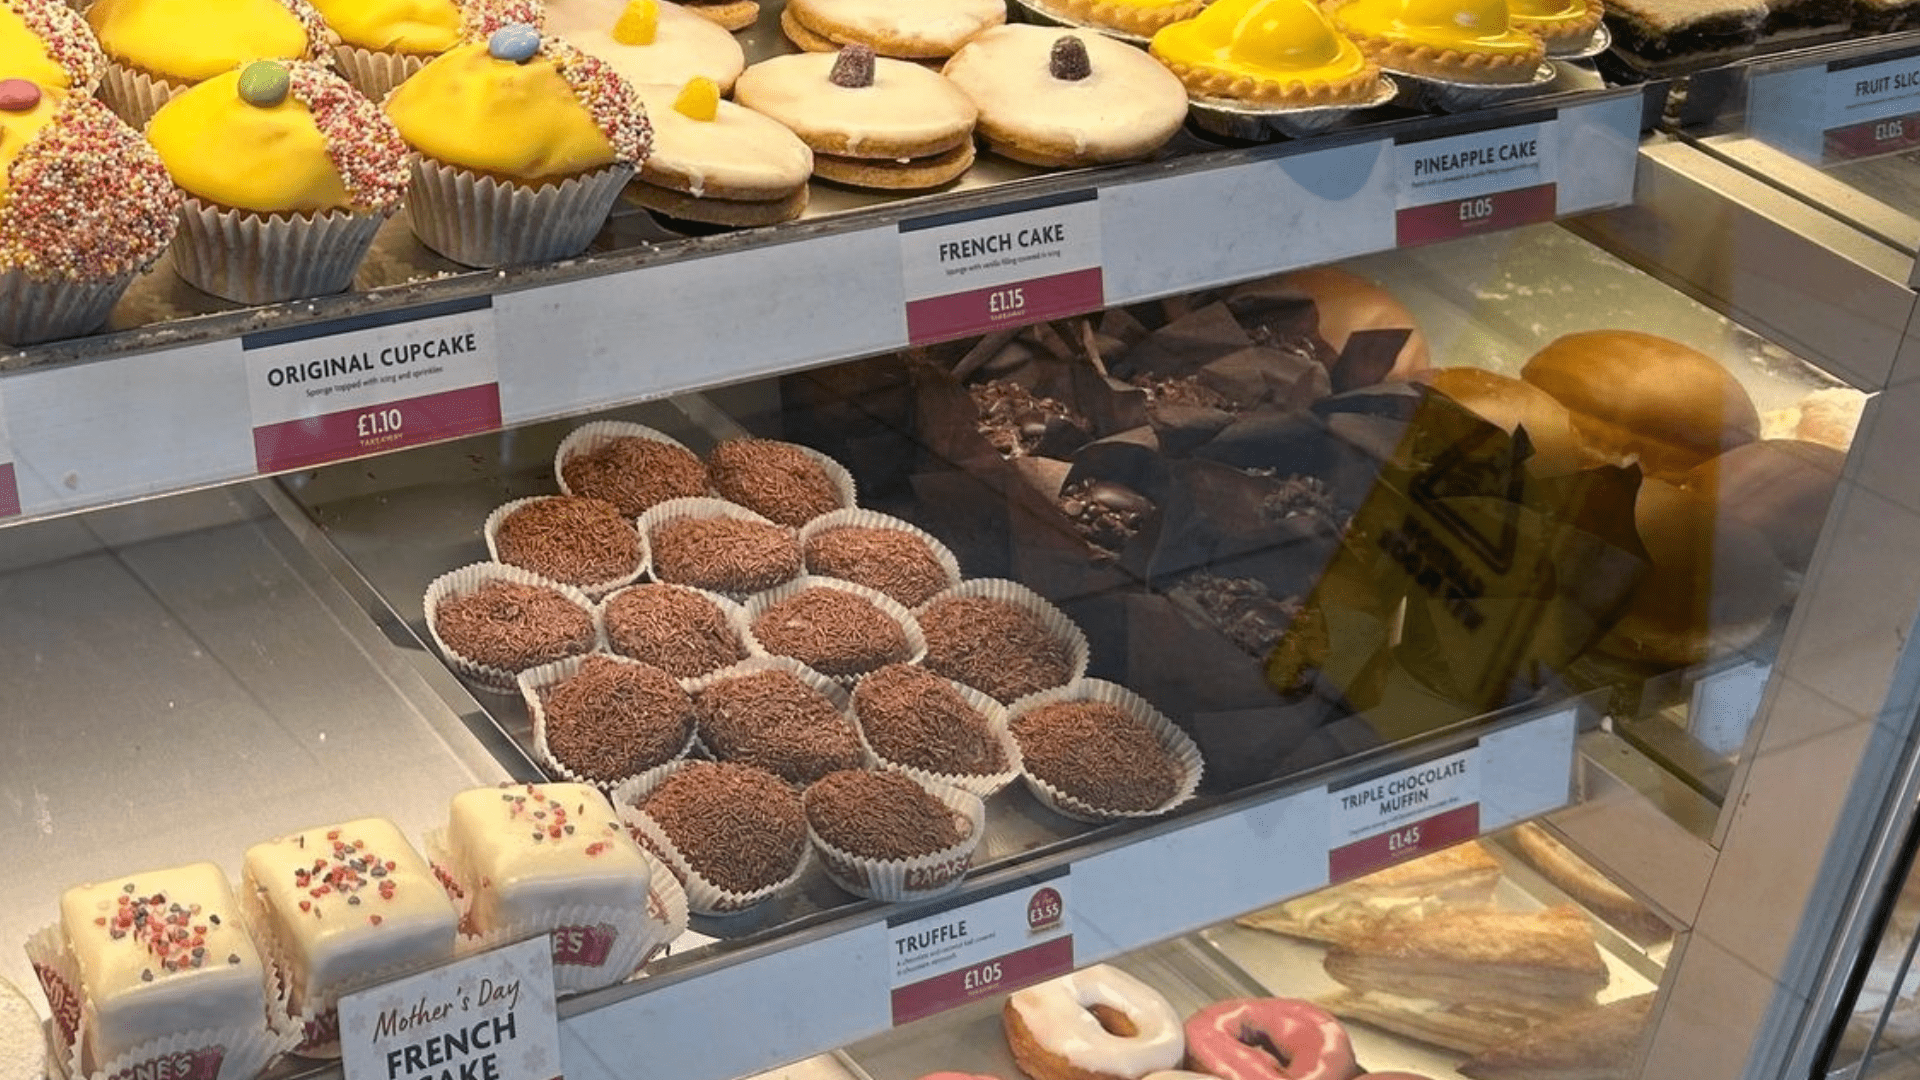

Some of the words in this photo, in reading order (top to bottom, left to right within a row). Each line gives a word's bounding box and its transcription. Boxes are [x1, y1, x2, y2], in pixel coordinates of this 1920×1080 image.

[1855, 76, 1891, 97] FRUIT
[1414, 147, 1495, 176] PINEAPPLE
[1498, 140, 1538, 161] CAKE
[1459, 198, 1493, 221] £1.05
[939, 233, 1012, 263] FRENCH
[1017, 224, 1065, 248] CAKE
[989, 288, 1025, 313] £1.15
[267, 352, 374, 387] ORIGINAL
[380, 333, 477, 365] CUPCAKE
[306, 387, 333, 398] Sponge
[334, 380, 361, 392] topped
[363, 377, 378, 386] with
[398, 370, 411, 380] and
[412, 366, 443, 379] sprinkles
[357, 408, 402, 437] £1.10
[1341, 786, 1385, 811] TRIPLE
[1387, 759, 1466, 796] CHOCOLATE
[1379, 788, 1429, 816] MUFFIN
[1388, 826, 1421, 851] £1.45
[1030, 902, 1060, 923] £3.55
[895, 920, 967, 955] TRUFFLE
[963, 962, 1003, 990] £1.05
[373, 986, 470, 1044] Mother's
[478, 978, 520, 1011] Day
[386, 1012, 517, 1080] FRENCH
[418, 1053, 499, 1080] KE
